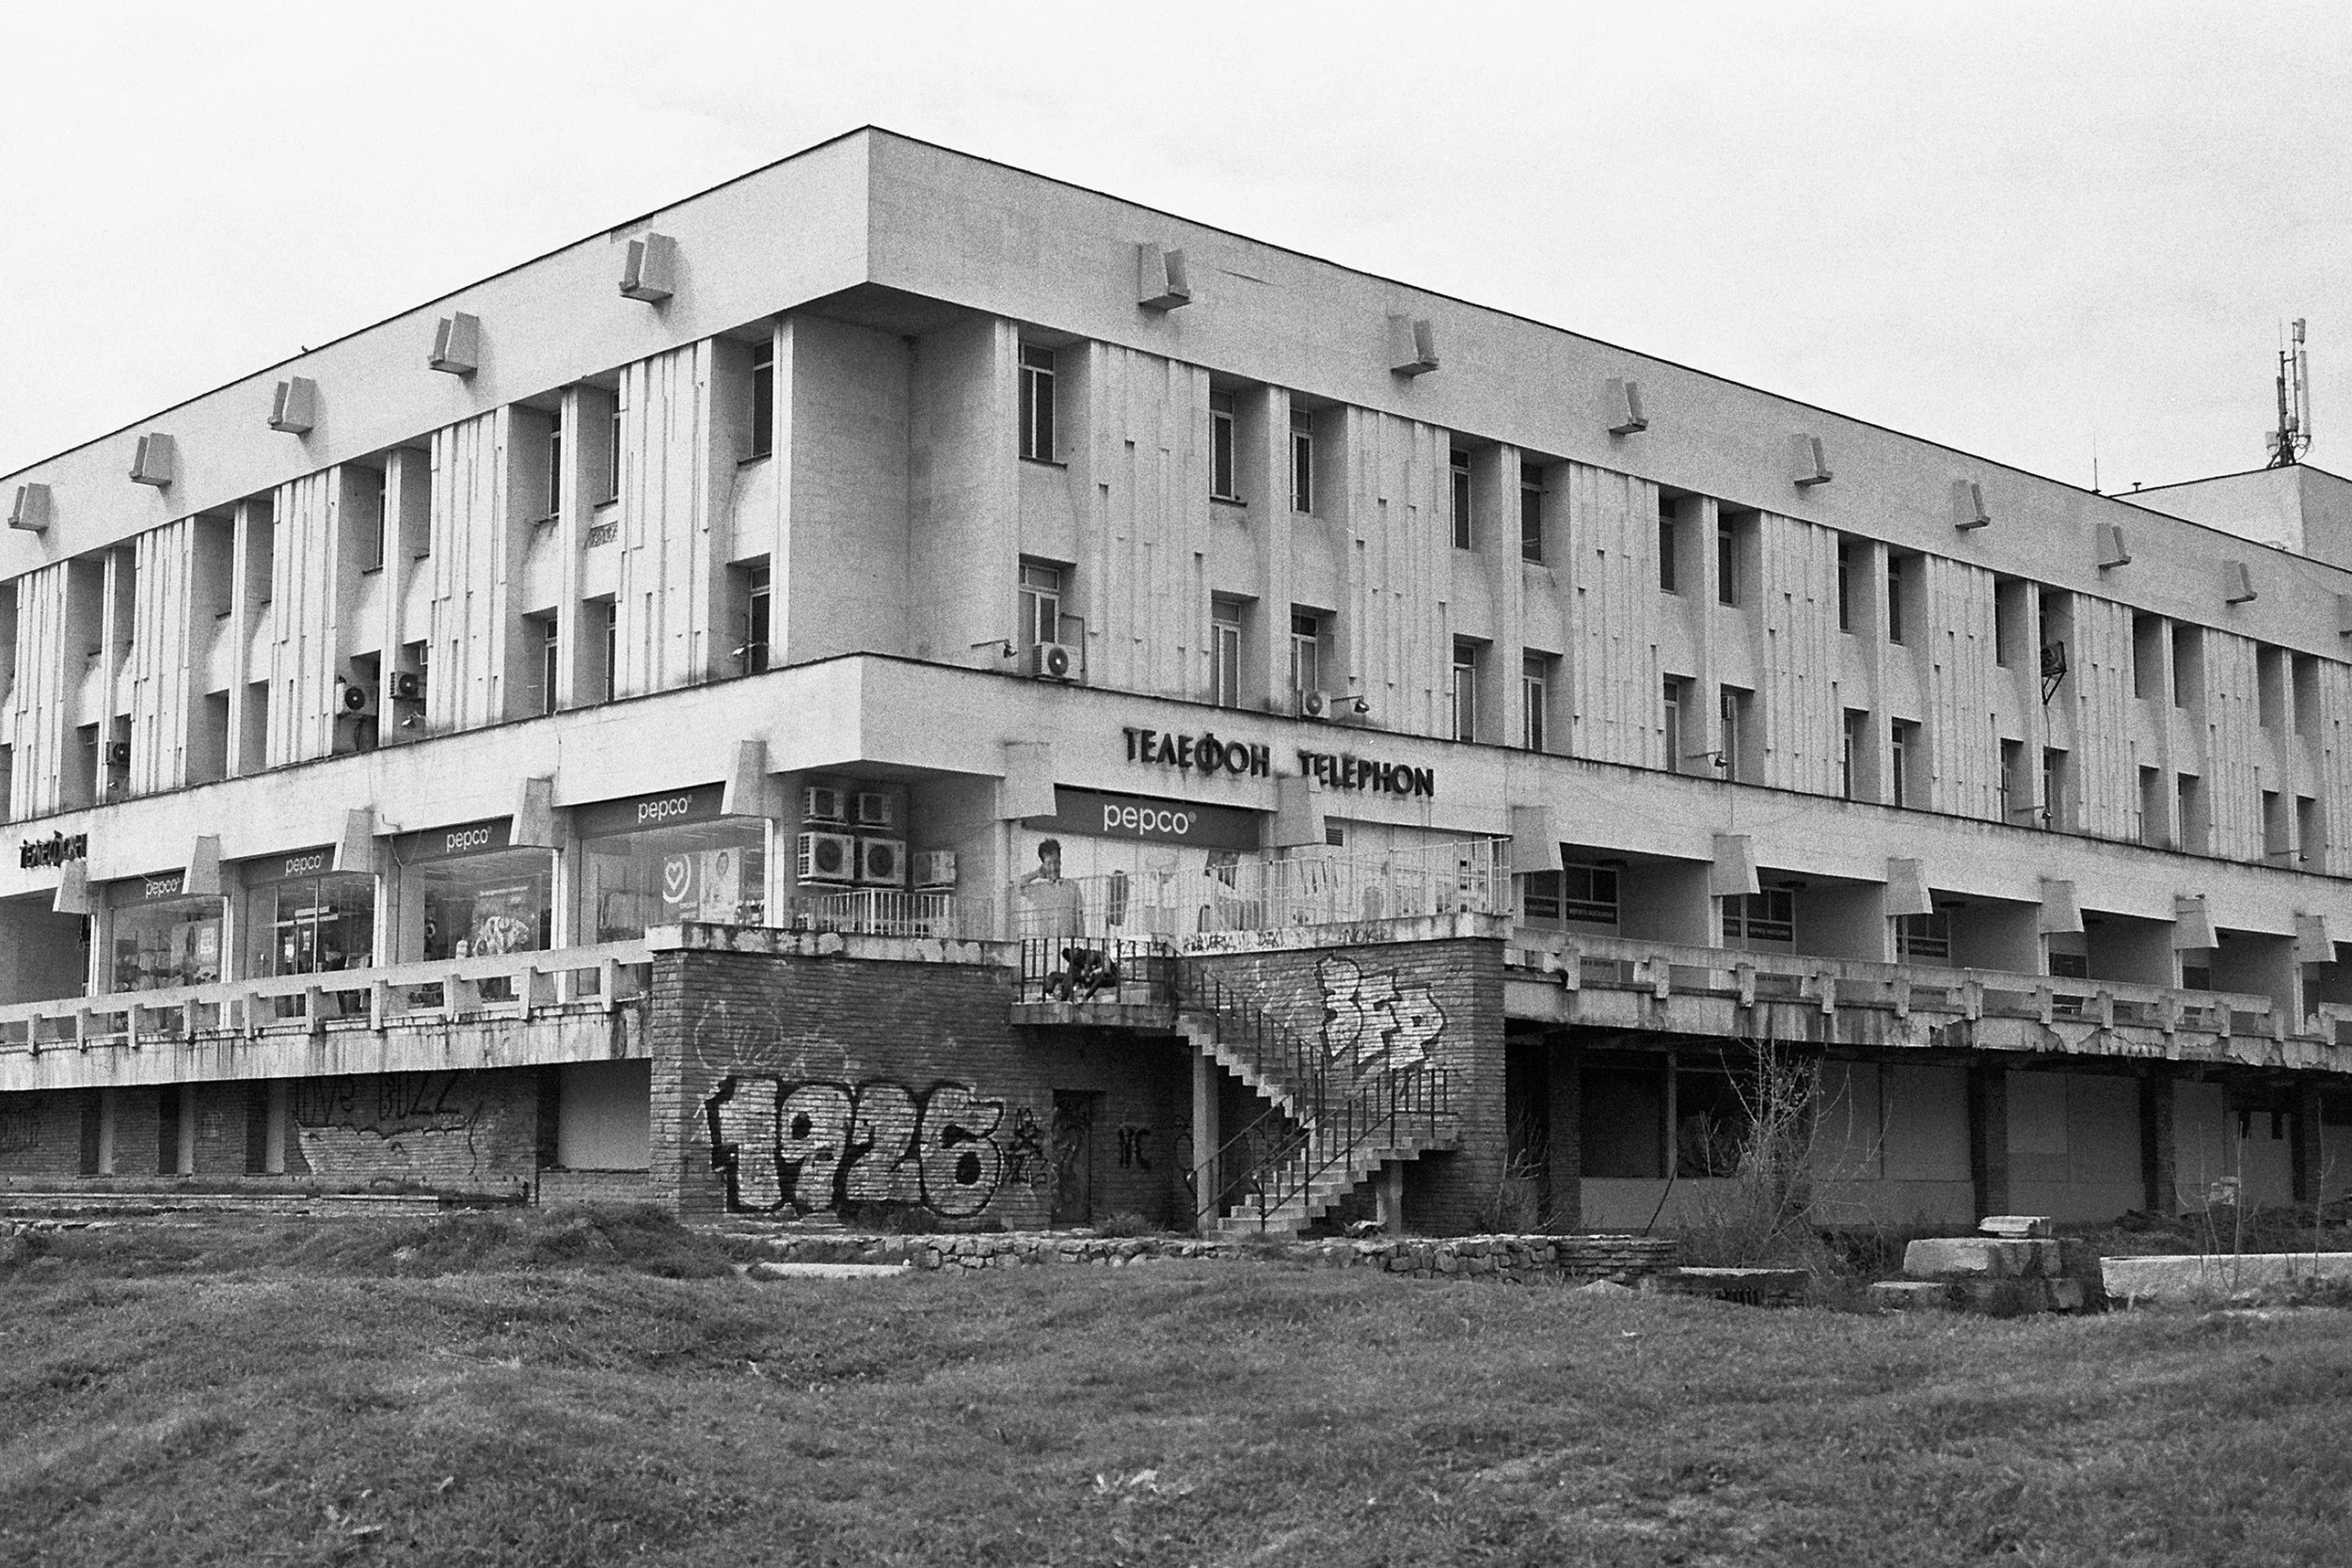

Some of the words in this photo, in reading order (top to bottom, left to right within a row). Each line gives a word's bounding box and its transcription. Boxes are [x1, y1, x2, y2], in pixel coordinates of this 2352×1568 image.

[1122, 727, 1270, 778] ТЕЛЕФОН
[1296, 750, 1435, 798] TELEPHON
[638, 797, 689, 823] pepco
[1104, 803, 1189, 835] pepco
[446, 827, 488, 852] pepco
[285, 854, 322, 876] pepco
[145, 879, 178, 899] pepco
[704, 1074, 1004, 1220] 1926
